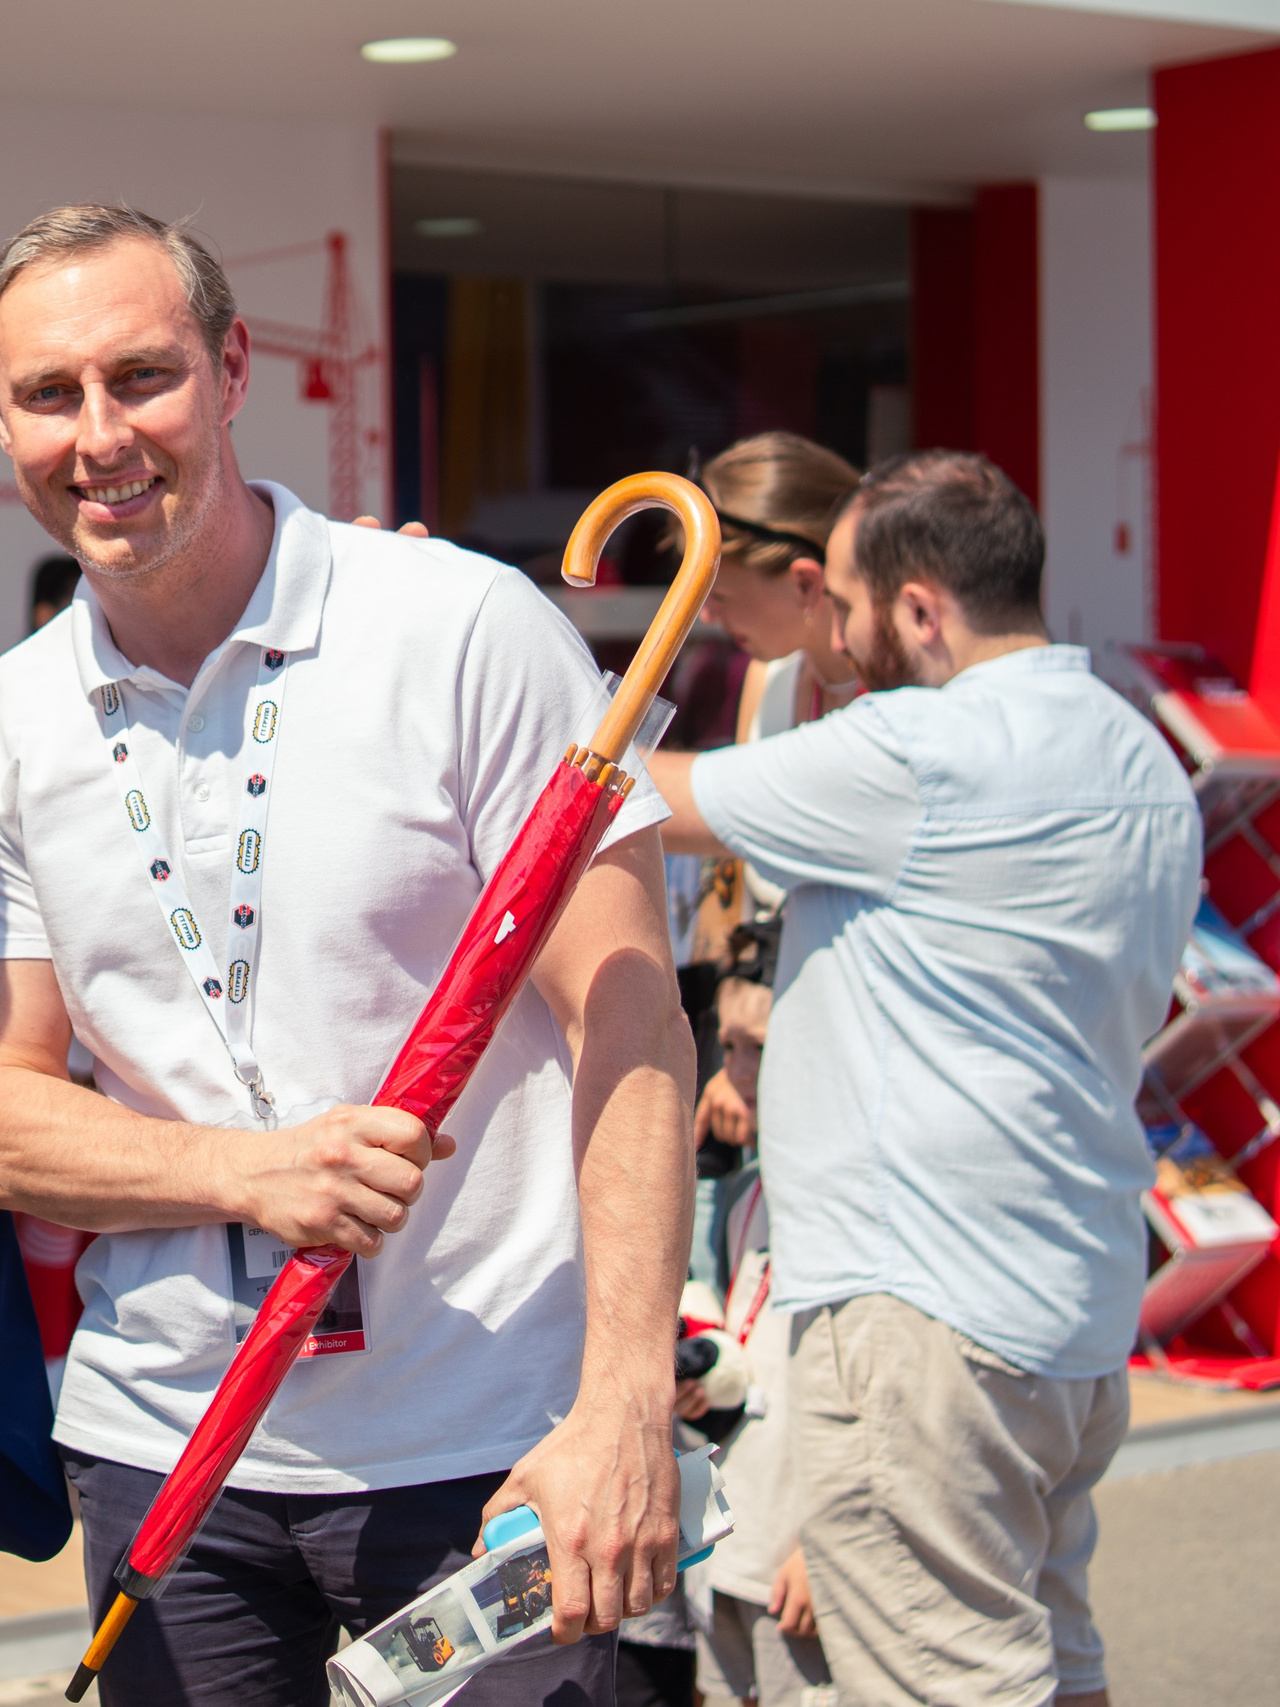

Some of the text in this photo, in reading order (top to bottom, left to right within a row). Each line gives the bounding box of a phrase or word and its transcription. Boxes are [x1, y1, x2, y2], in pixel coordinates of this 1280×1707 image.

[245, 836, 253, 858] ГРУПП
[181, 922, 195, 943] ГРУПП
[308, 1339, 347, 1351] Exhibitor
